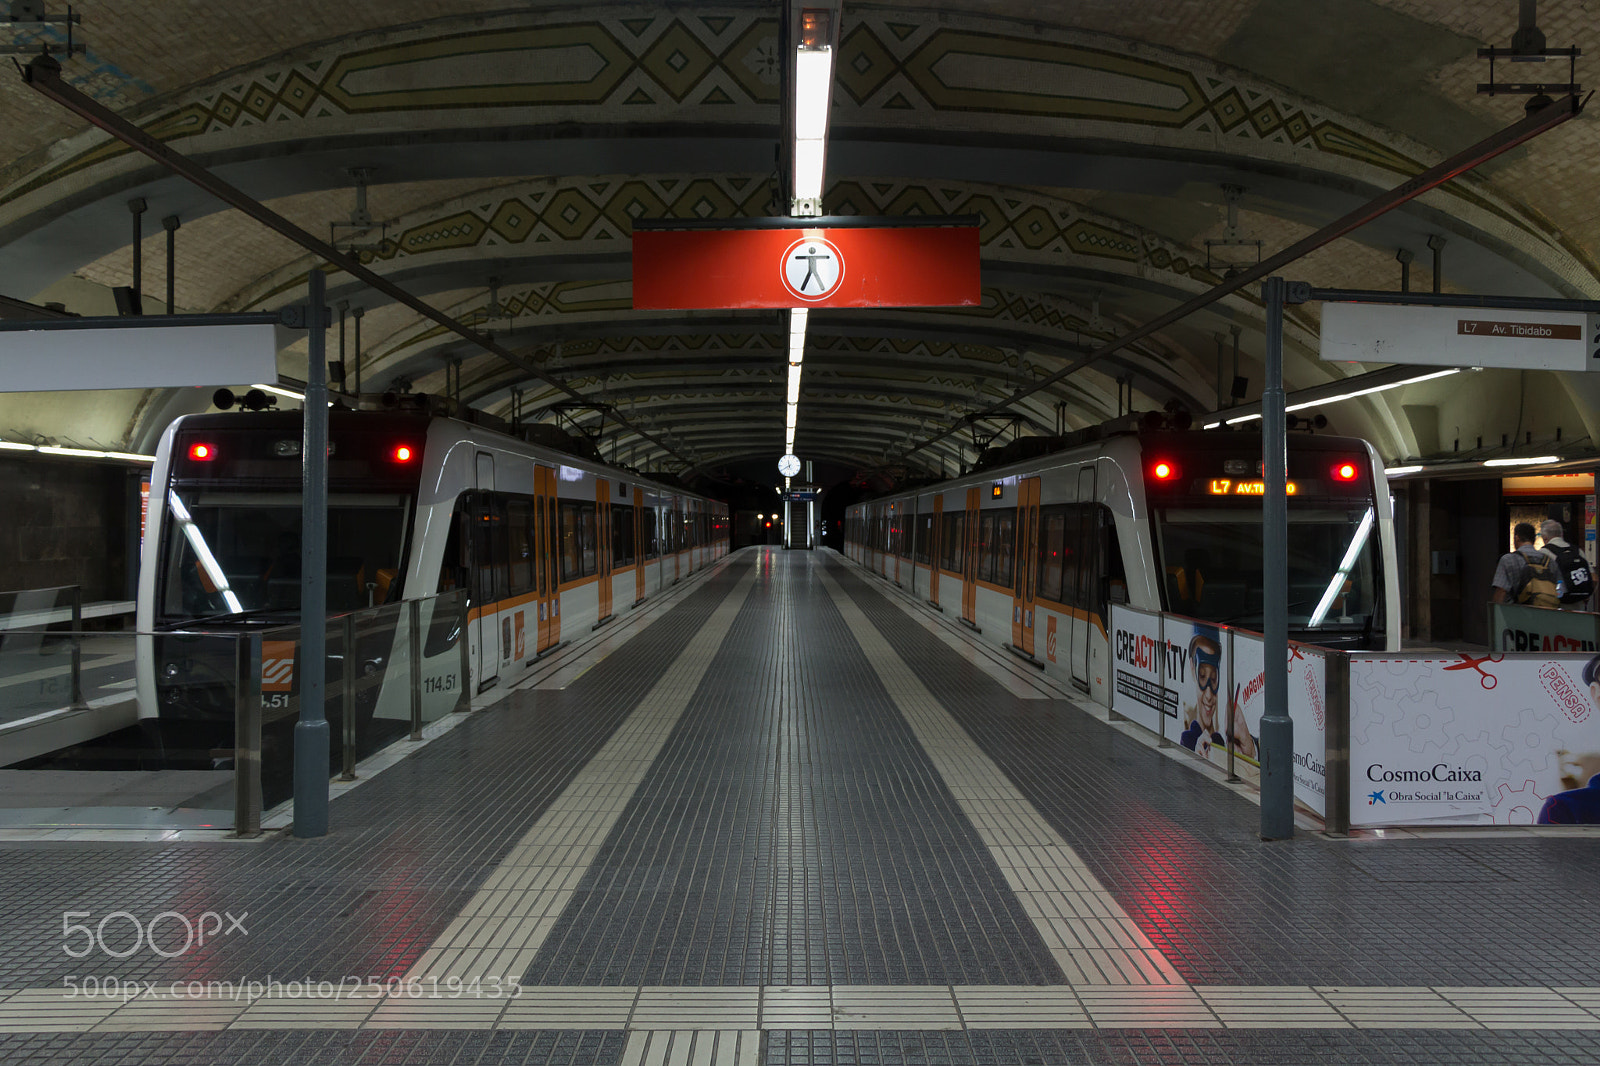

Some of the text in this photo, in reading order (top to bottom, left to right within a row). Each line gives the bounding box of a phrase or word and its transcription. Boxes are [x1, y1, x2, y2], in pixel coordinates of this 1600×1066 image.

[1464, 322, 1552, 337] L7 Av. Tibidabo
[1212, 480, 1230, 493] L7
[424, 674, 457, 693] 114.51
[1242, 671, 1265, 705] IMAGIN
[1543, 667, 1586, 718] PENSA
[1366, 764, 1482, 782] CosmoCaixa
[1389, 791, 1413, 801] Obra
[1414, 791, 1441, 801] Social
